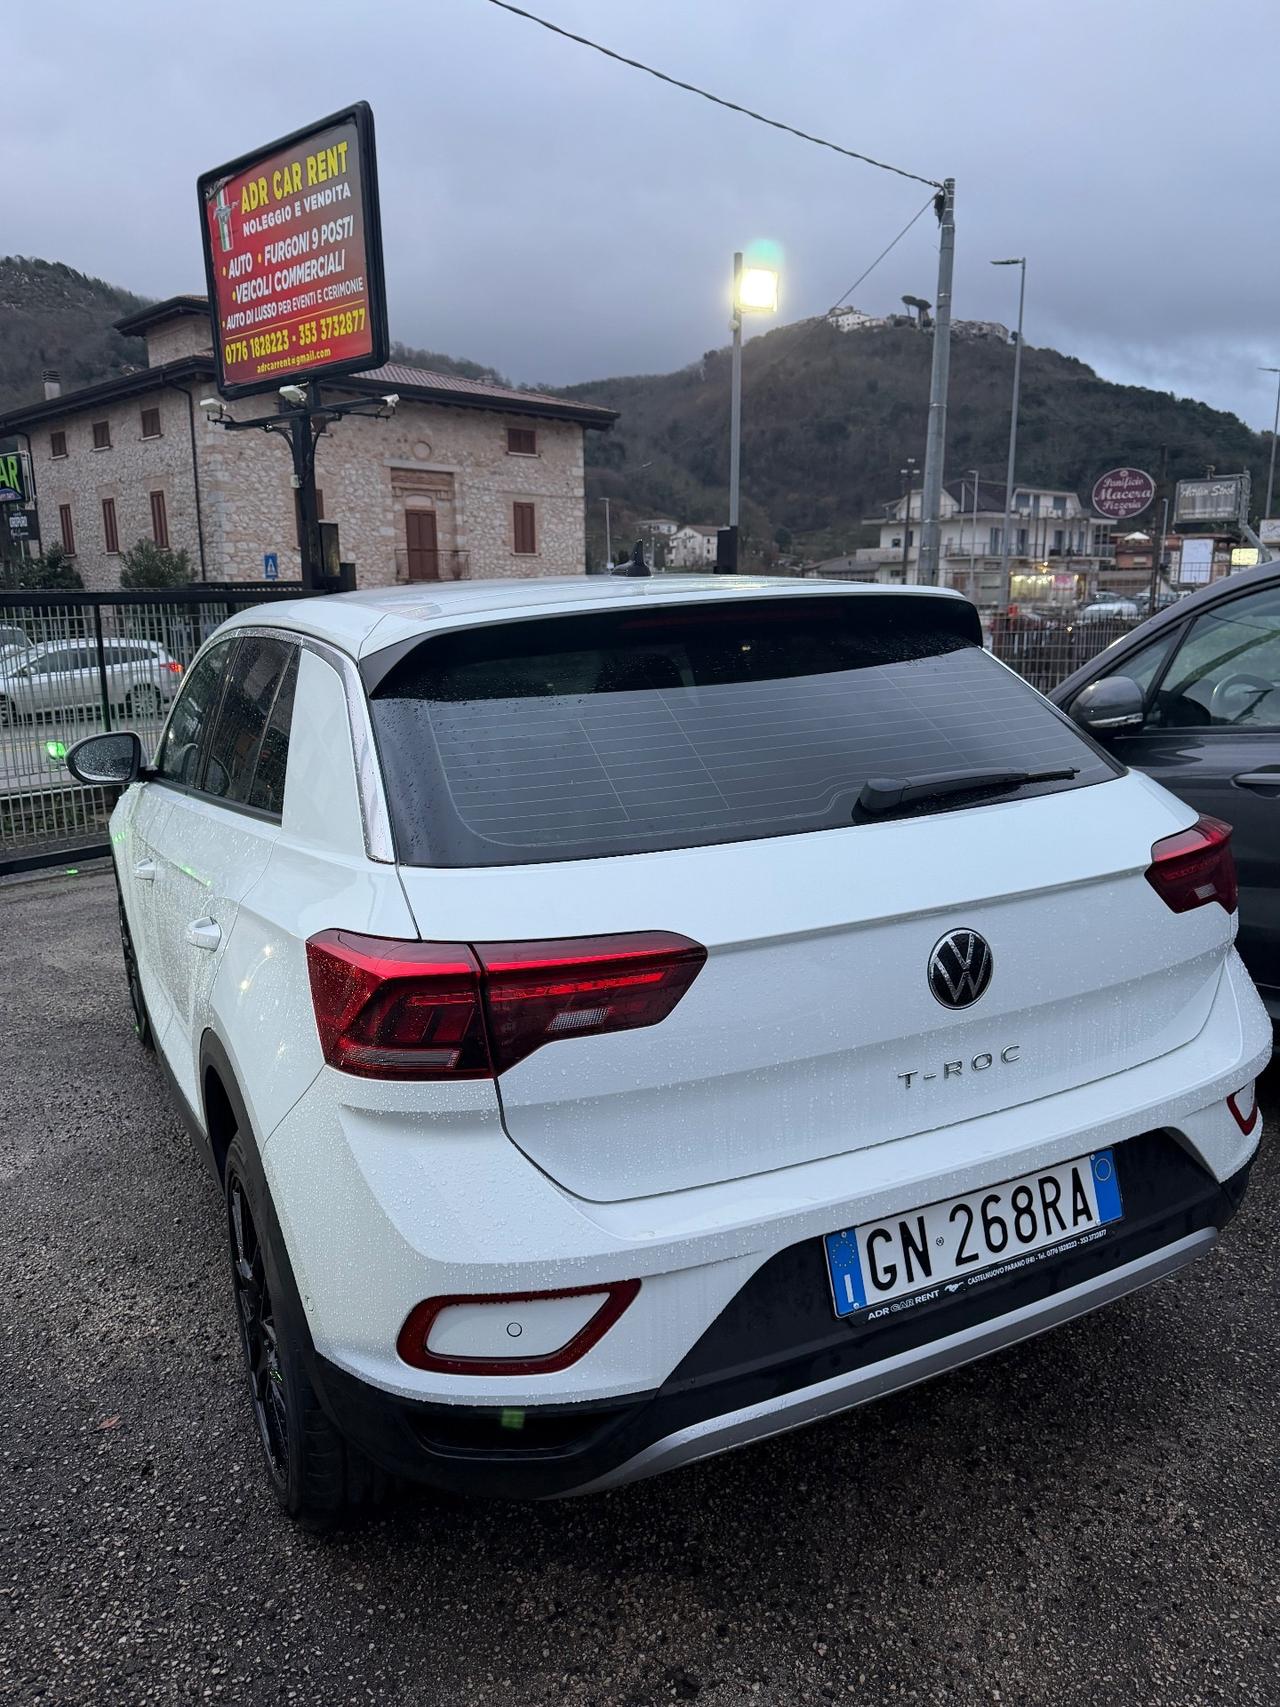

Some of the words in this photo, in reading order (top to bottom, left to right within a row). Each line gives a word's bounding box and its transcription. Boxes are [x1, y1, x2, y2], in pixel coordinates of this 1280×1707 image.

[241, 177, 269, 214] ADR
[273, 162, 302, 200] CAR
[306, 141, 348, 186] RENT
[243, 205, 292, 237] NOLEGGIO
[295, 202, 301, 216] E
[304, 182, 351, 212] VENDITA
[228, 253, 253, 279] AUTO
[264, 231, 310, 266] FURGONI
[312, 228, 318, 250] 9
[321, 215, 354, 246] POSTI
[236, 274, 272, 304] VEICOLI
[274, 249, 345, 292] COMMERCIALI
[227, 313, 245, 330] AUTO
[246, 311, 254, 325] DI
[255, 302, 277, 322] LUSSO
[278, 299, 292, 315] PER
[293, 292, 316, 311] EVENTI
[317, 291, 323, 303] E
[323, 277, 364, 301] CERIMONIE
[225, 340, 248, 365] 0776
[250, 329, 290, 359] 1828223
[298, 321, 317, 346] 353
[320, 308, 366, 340] 3732877
[257, 348, 331, 374] adrcarrent@gmail.com
[1094, 488, 1151, 500] Macera
[1102, 499, 1141, 510] Pizzeria
[1103, 476, 1144, 489] Panificio
[897, 1044, 1020, 1089] T-ROC
[866, 1216, 932, 1291] GN
[949, 1166, 1093, 1267] 268RA
[967, 1266, 1004, 1285] CASTELNUOVO
[1004, 1259, 1026, 1275] PARANO
[1046, 1248, 1058, 1257] 0776
[868, 1307, 890, 1320] ADR
[890, 1298, 914, 1312] CAR
[915, 1290, 940, 1304] RENT
